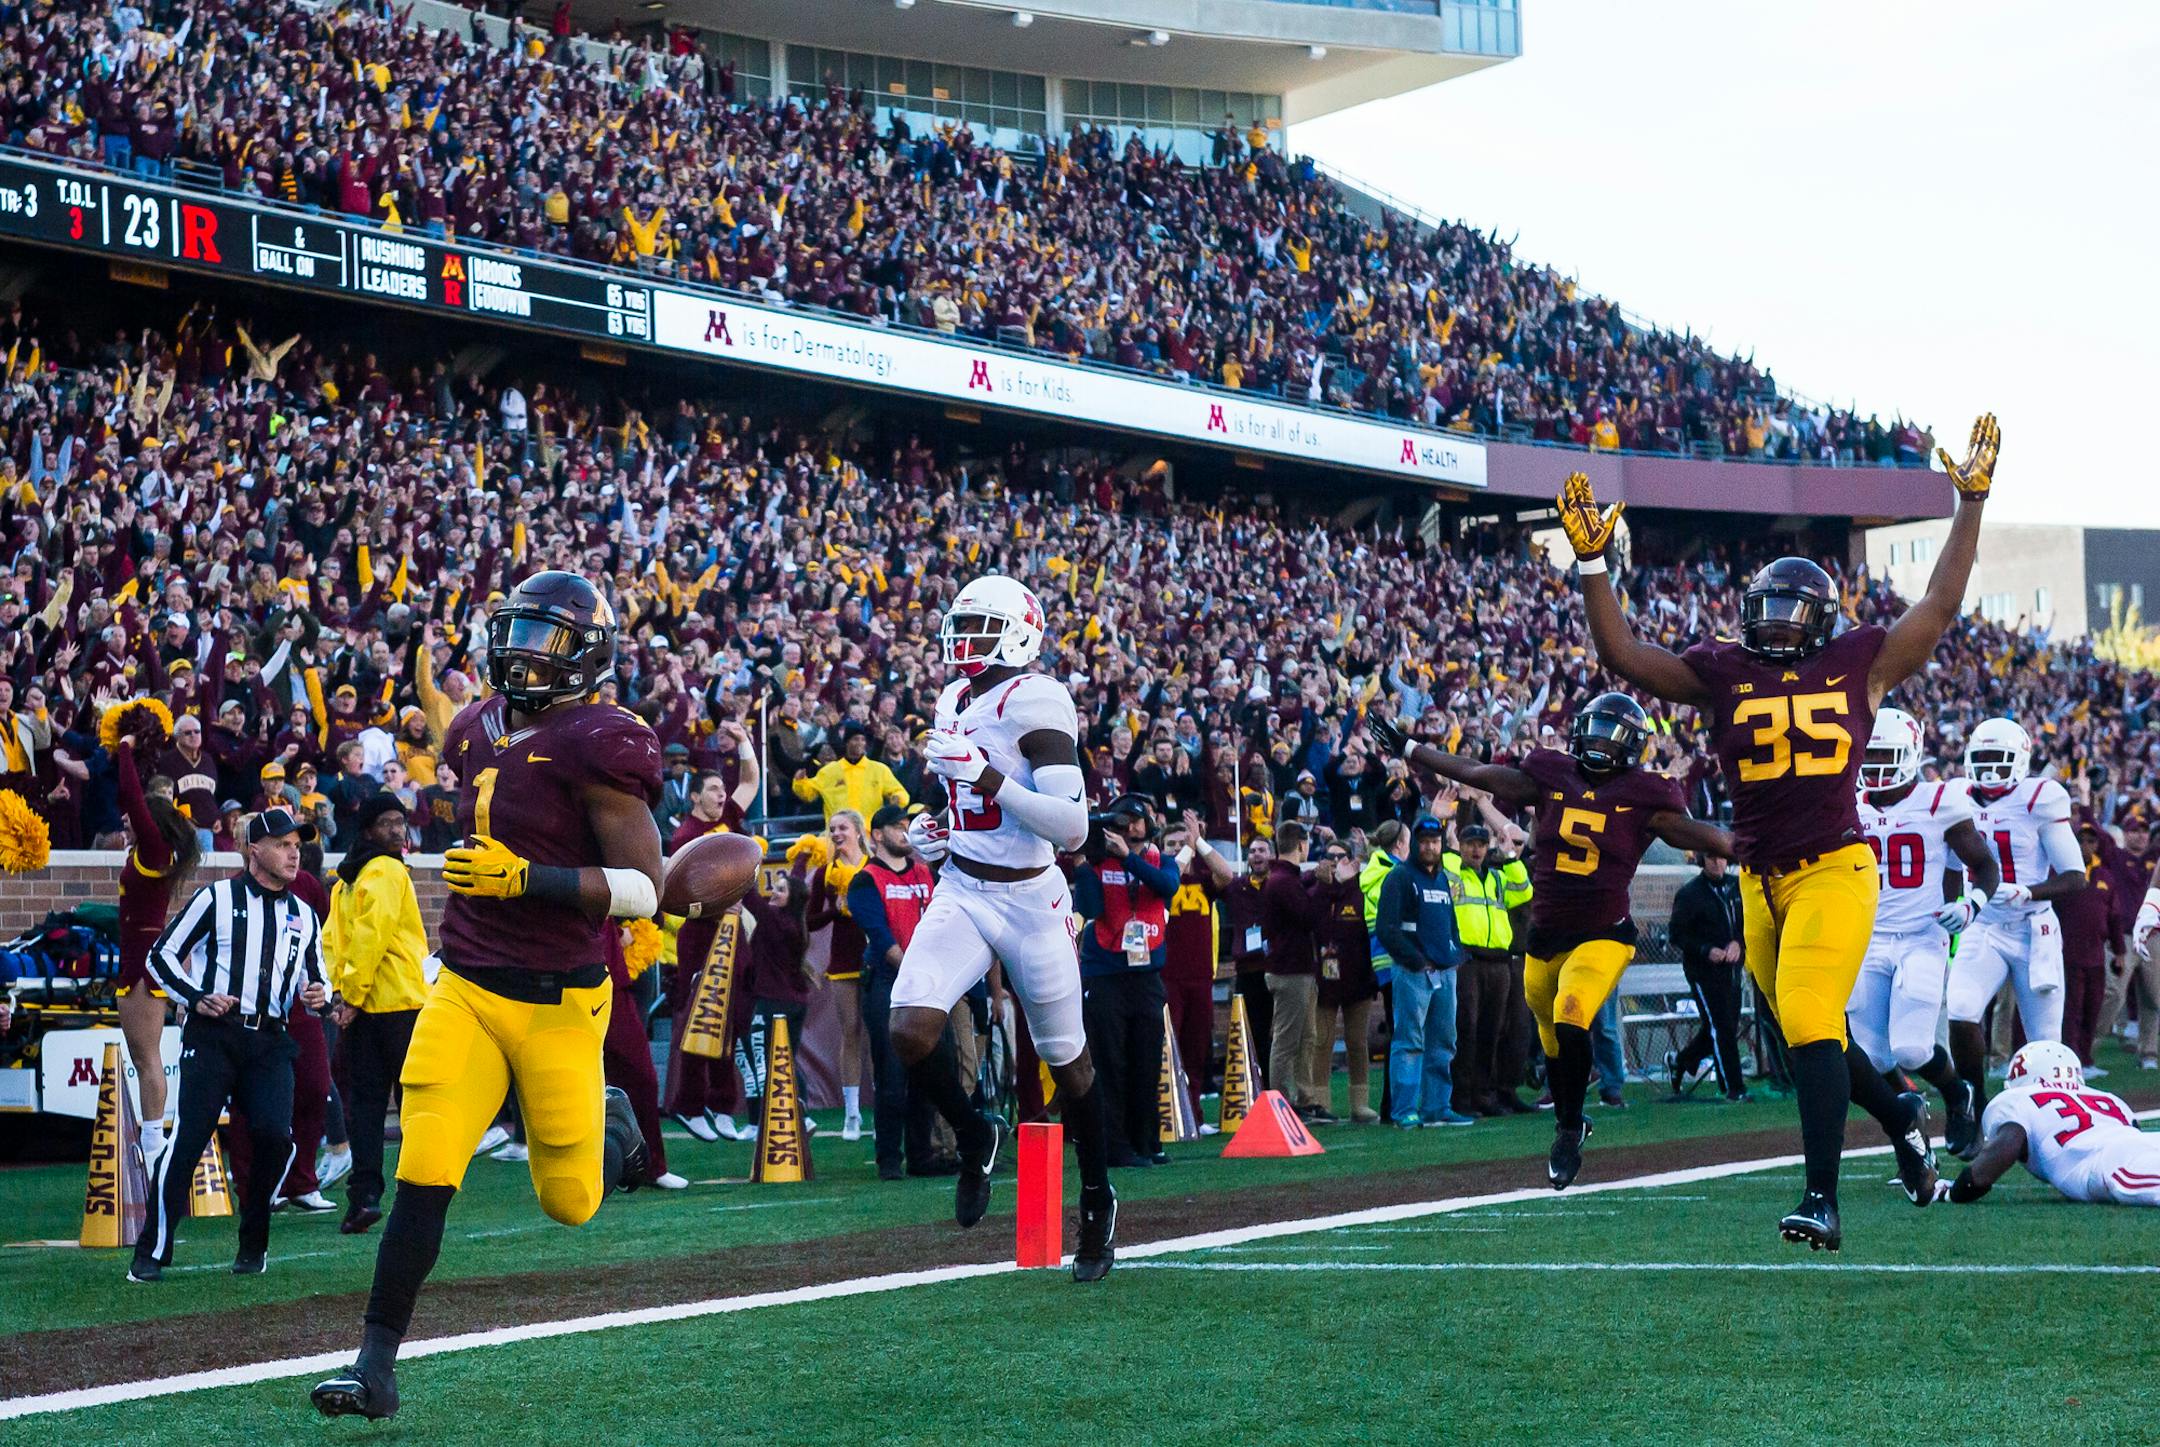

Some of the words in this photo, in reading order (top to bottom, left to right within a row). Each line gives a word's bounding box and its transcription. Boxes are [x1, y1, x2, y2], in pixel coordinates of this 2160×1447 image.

[24, 184, 38, 217] 3
[70, 207, 83, 240] 3
[124, 194, 160, 248] 23
[182, 205, 222, 263] R
[294, 226, 305, 249] &
[259, 249, 293, 274] BALL
[297, 256, 315, 278] ON
[361, 236, 425, 271] RUSHING
[441, 253, 466, 282] M
[362, 266, 427, 300] LEADERS
[474, 257, 522, 288] BROOKS
[444, 281, 462, 305] R
[704, 309, 733, 347] M
[743, 322, 756, 347] is
[763, 324, 788, 352] for
[968, 359, 993, 392] M
[1001, 369, 1013, 392] is
[1018, 371, 1039, 397] for
[1207, 404, 1228, 433] M
[1233, 412, 1246, 432] is
[1248, 414, 1267, 438] for
[1270, 416, 1285, 441] all
[1288, 419, 1301, 443] of
[1400, 439, 1418, 466] M
[1421, 448, 1458, 469] HEALTH
[1781, 671, 1799, 682] M
[1732, 691, 1852, 782] 35
[472, 765, 499, 828] 1
[1555, 807, 1606, 876] 5
[1170, 884, 1210, 916] M
[1422, 889, 1451, 905] ESPN
[289, 945, 298, 961] F
[690, 923, 734, 1039] SKI-U-MAH
[68, 1057, 99, 1087] M
[1223, 1020, 1247, 1121] SKI-U-MAH
[767, 1046, 798, 1166] SKI-U-MAH
[2030, 1091, 2130, 1147] 39
[85, 1067, 115, 1216] SKI-U-MAH
